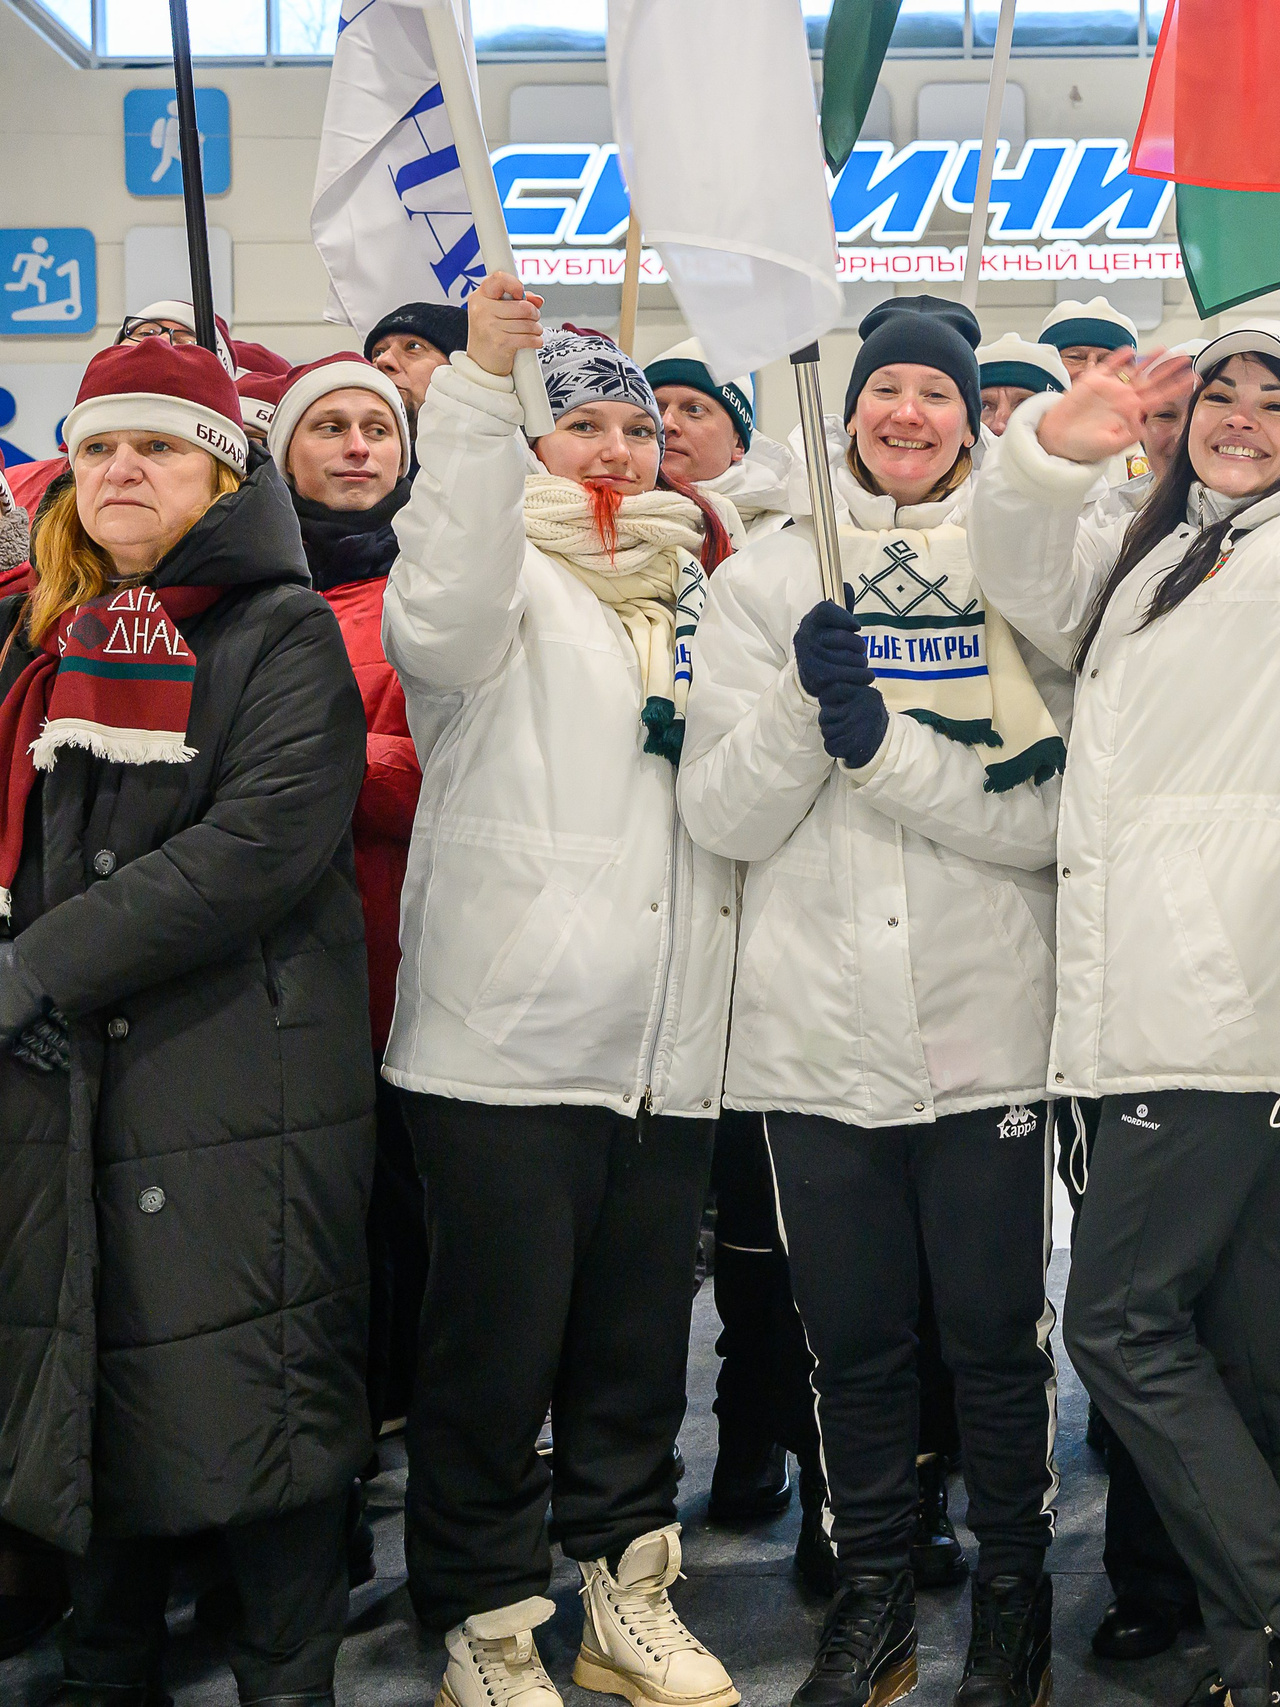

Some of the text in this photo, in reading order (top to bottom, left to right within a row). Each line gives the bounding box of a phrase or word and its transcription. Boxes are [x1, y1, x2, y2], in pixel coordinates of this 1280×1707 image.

[904, 633, 980, 663] ТИГРЫ
[999, 1119, 1037, 1139] Kappa
[1120, 1113, 1161, 1131] NORDWAY
